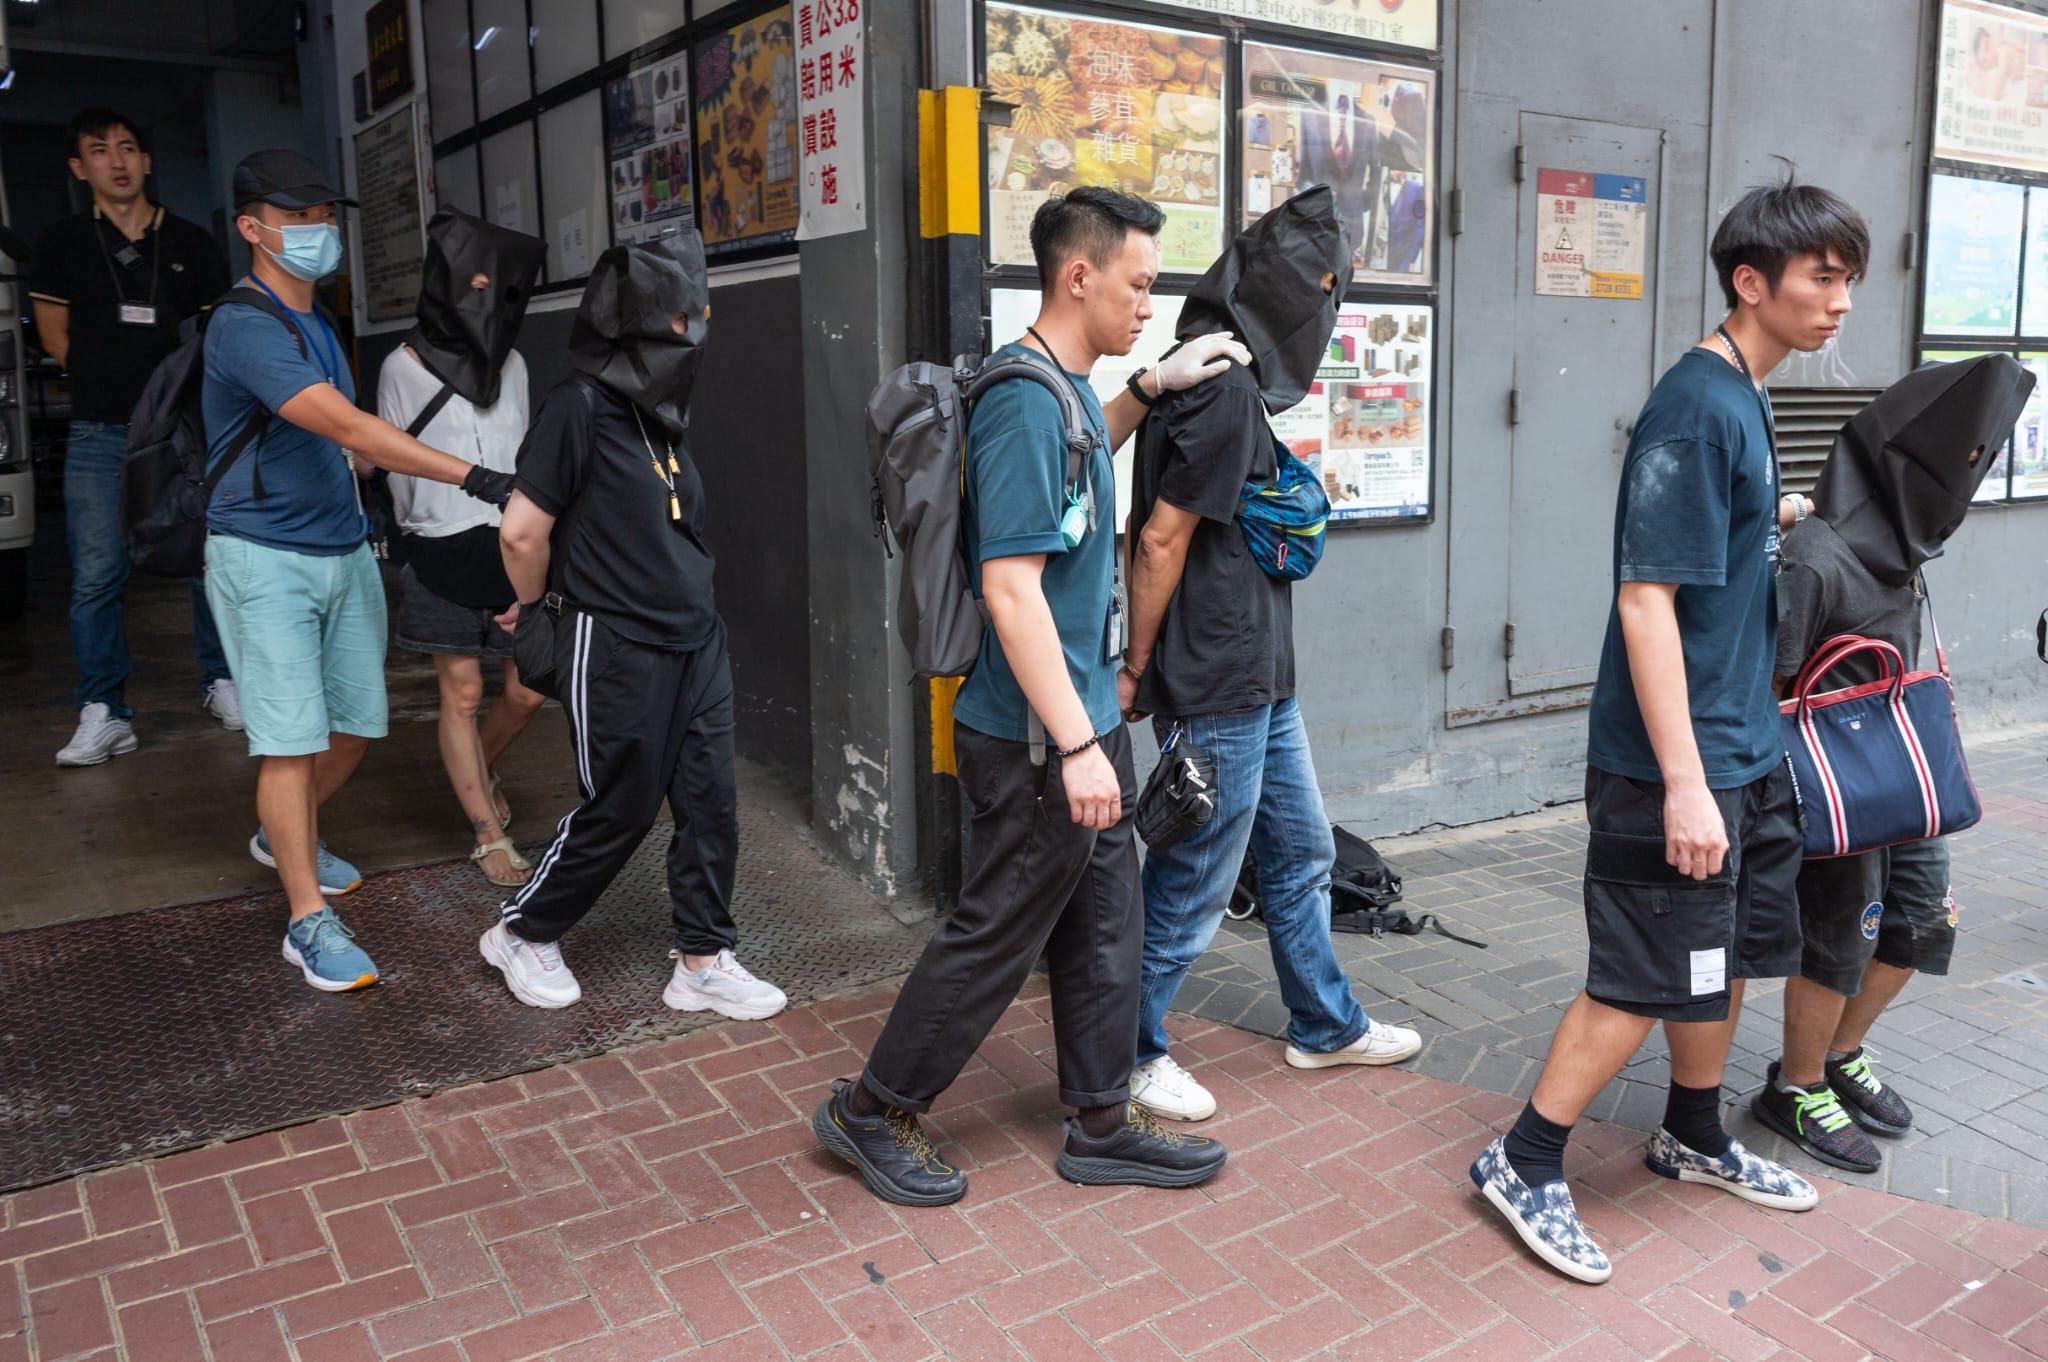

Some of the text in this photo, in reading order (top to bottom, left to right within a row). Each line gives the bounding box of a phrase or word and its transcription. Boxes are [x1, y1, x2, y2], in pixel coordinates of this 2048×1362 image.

[1087, 48, 1136, 85] 海味
[815, 0, 838, 205] 公用設施
[1091, 129, 1139, 166] 雜貨
[1554, 199, 1576, 214] 危險
[1541, 252, 1585, 265] DANGER
